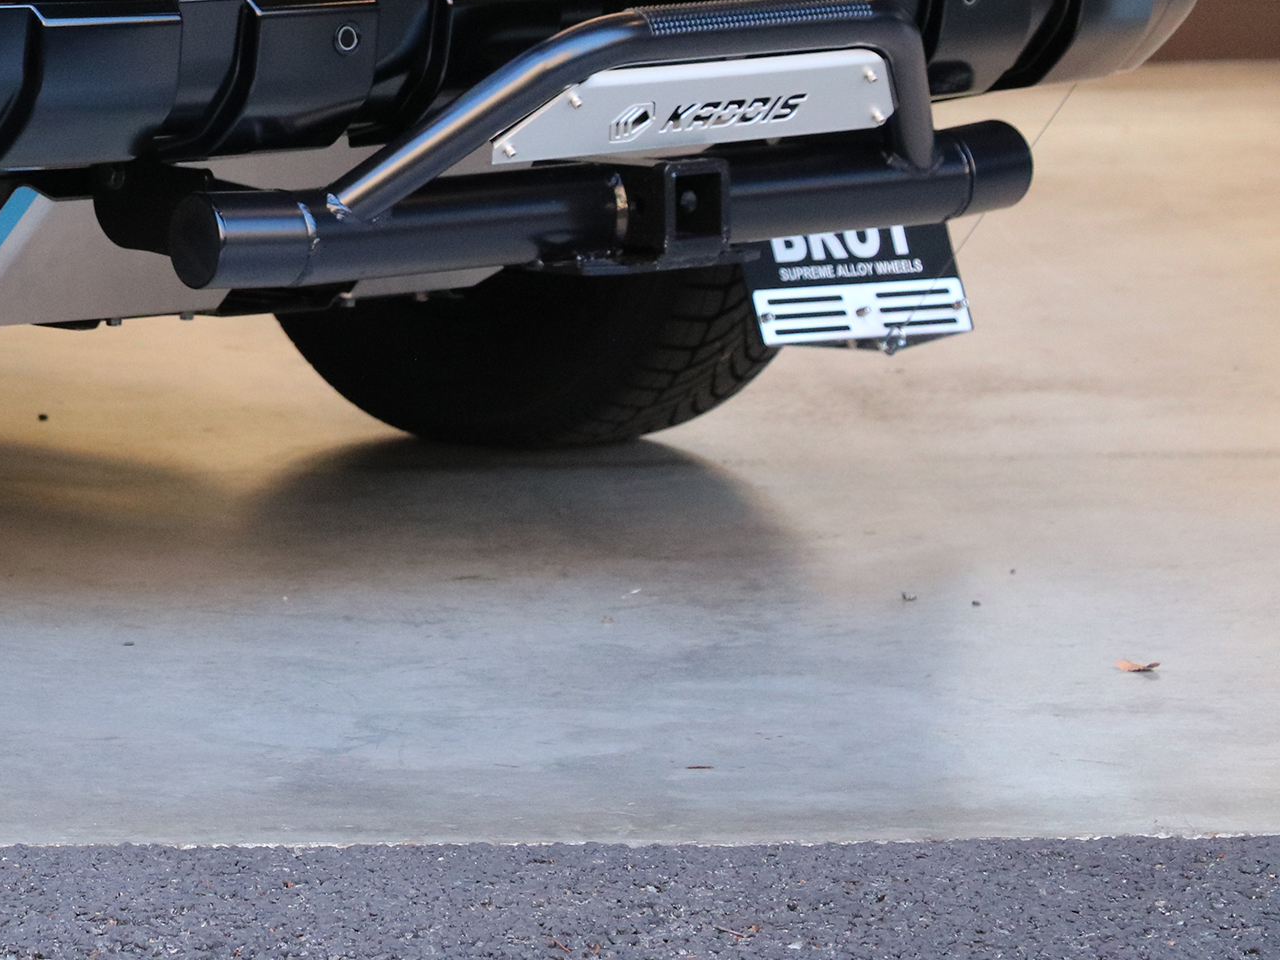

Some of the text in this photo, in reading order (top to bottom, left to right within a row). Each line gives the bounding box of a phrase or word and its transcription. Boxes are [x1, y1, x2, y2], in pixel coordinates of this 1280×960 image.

[778, 258, 923, 282] SUPREME ALLOY WHEELS
